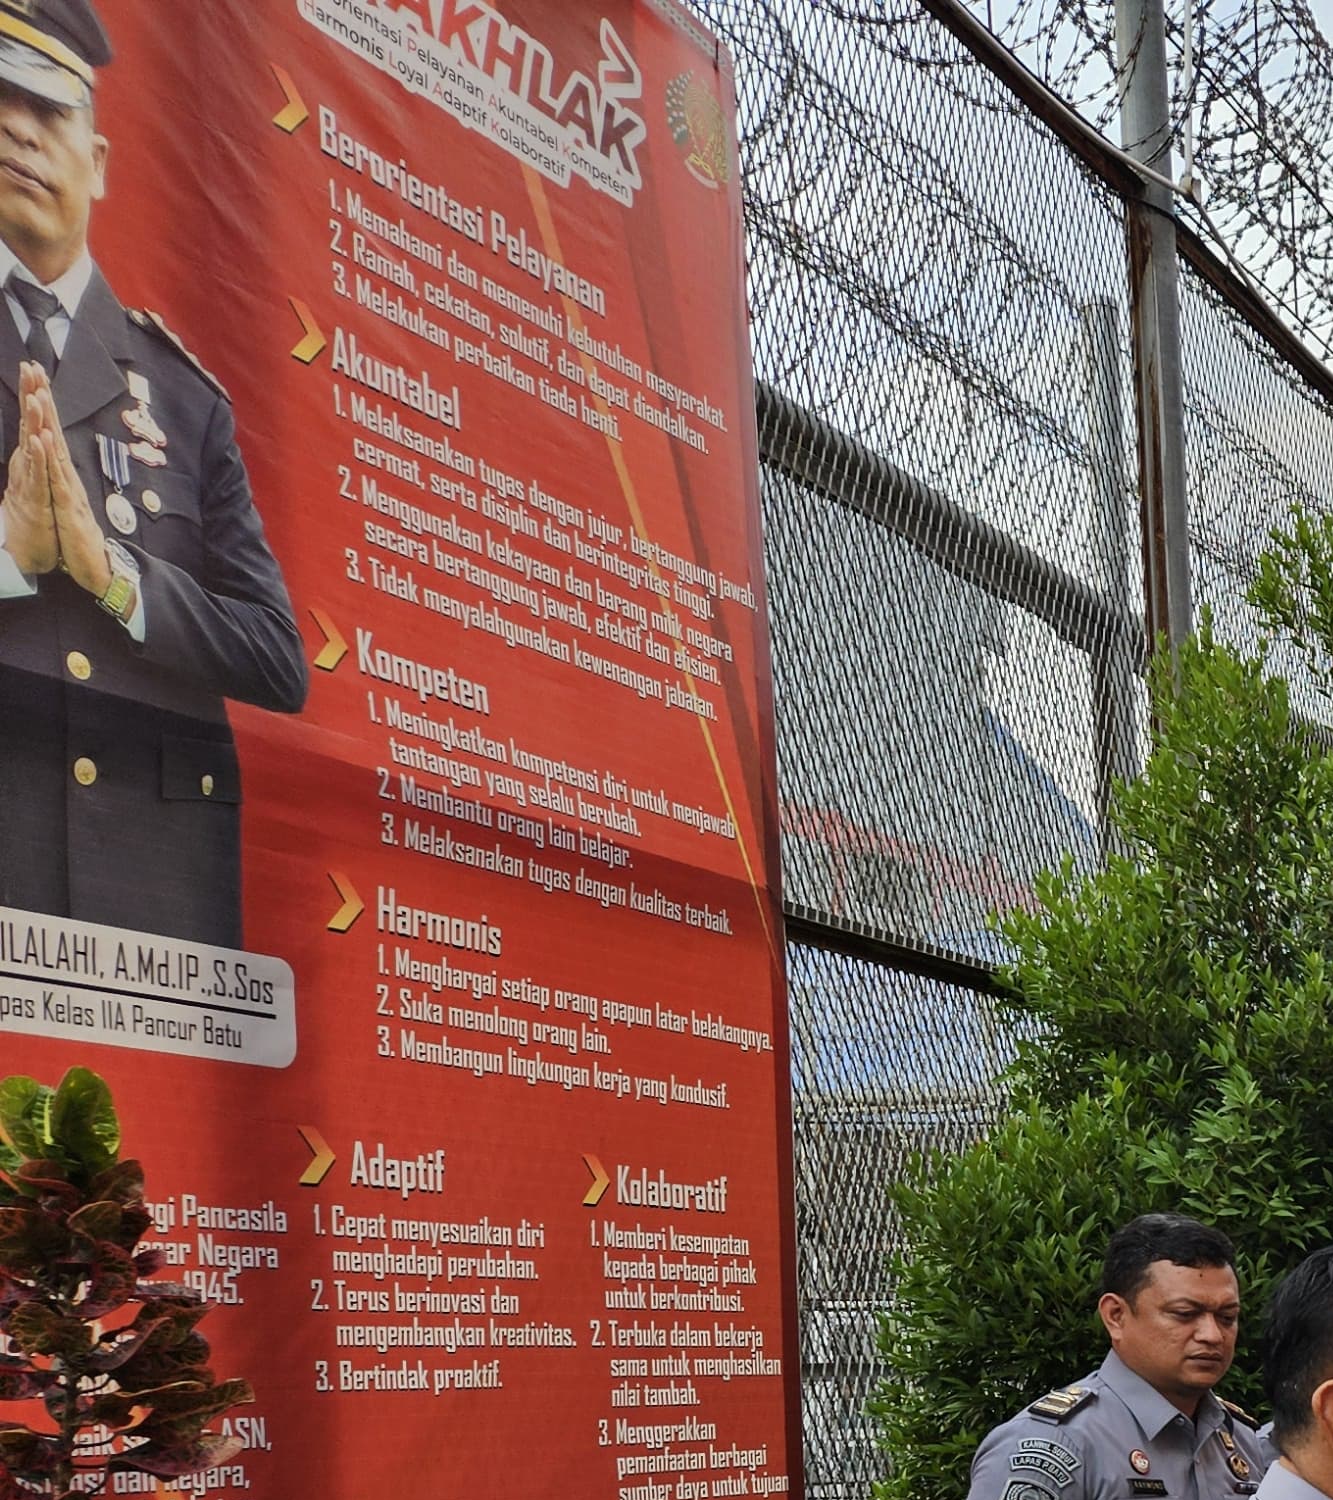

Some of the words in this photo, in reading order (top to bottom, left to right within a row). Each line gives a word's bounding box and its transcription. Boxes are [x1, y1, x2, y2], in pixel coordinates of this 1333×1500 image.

[303, 0, 384, 60] Harmonis
[389, 51, 428, 89] Loyal
[432, 82, 487, 128] Adaptif
[491, 118, 566, 179] Kolaboratif
[333, 0, 402, 46] orientasi
[407, 38, 484, 101] Pelayanan
[488, 93, 558, 152] Akuntabel
[562, 144, 629, 200] Kompeten
[366, 0, 638, 176] AKHLAK
[319, 103, 484, 245] Berorientasi
[491, 210, 605, 317] Pelayanan
[346, 187, 443, 271] Memahami
[447, 249, 478, 290] dan
[482, 276, 563, 338] memenuhi
[567, 316, 642, 383] kebutuhan
[646, 370, 728, 431] masyarakat.
[353, 231, 419, 298] Ramah,
[424, 280, 495, 339] cekatan,
[500, 323, 553, 371] solutif,
[557, 348, 585, 386] dan
[589, 367, 630, 411] dapat
[633, 392, 709, 454] diandalkan.
[356, 273, 450, 351] Melakukan
[454, 336, 535, 395] perbaikan
[538, 377, 577, 418] tiada
[581, 395, 623, 441] henti.
[332, 326, 461, 430] Akuntabel
[351, 391, 475, 477] Melaksanakan
[479, 458, 524, 500] tugas
[528, 480, 584, 528] dengan
[630, 525, 716, 596] bertanggung
[719, 572, 758, 612] jawab,
[354, 438, 425, 489] cermat,
[430, 472, 477, 512] serta
[481, 488, 539, 538] disiplin
[543, 518, 571, 553] dan
[575, 530, 670, 599] berintegritas
[673, 582, 715, 621] tinggi.
[362, 475, 482, 554] Menggunakan
[486, 530, 560, 588] kekayaan
[565, 566, 592, 601] dan
[595, 578, 647, 630] barang
[651, 609, 683, 641] milik
[686, 626, 733, 661] negara
[367, 556, 420, 604] Tidak
[424, 587, 570, 662] menyalahgunakan
[573, 639, 662, 699] kewenangan
[665, 679, 718, 721] jabatan.
[356, 627, 490, 714] Kompeten
[384, 696, 507, 763] Meningkatkan
[510, 737, 600, 794] kompetensi
[603, 770, 628, 803] diri
[631, 787, 670, 816] untuk
[672, 801, 736, 839] menjawab
[389, 737, 481, 788] tantangan
[484, 770, 526, 807] yang
[528, 780, 575, 816] selalu
[577, 791, 641, 836] berubah.
[400, 772, 492, 826] Membantu
[497, 810, 544, 848] orang
[548, 817, 575, 850] lain
[579, 826, 633, 868] belajar.
[0, 920, 104, 979] ILALAHI,
[377, 886, 501, 955] Harmonis
[0, 995, 35, 1023] pas
[43, 990, 94, 1027] Kelas
[101, 999, 126, 1032] IIA
[132, 1004, 197, 1041] Pancur
[203, 1015, 242, 1048] Batu
[395, 946, 497, 999] Menghargai
[501, 977, 550, 1011] setiap
[554, 989, 598, 1021] orang
[602, 1000, 652, 1027] apapun
[655, 1002, 688, 1033] latar
[691, 1009, 774, 1052] belakangnya.
[401, 1029, 503, 1076] Membangun
[508, 1047, 589, 1089] lingkungan
[593, 1061, 631, 1097] kerja
[634, 1075, 667, 1104] yang
[670, 1074, 730, 1108] kondusif.
[350, 1140, 445, 1199] Adaptif
[617, 1164, 727, 1212] Kolaboratif
[182, 1194, 288, 1232] Pancasila
[331, 1204, 387, 1243] Cepat
[391, 1215, 512, 1248] menyesuaikan
[517, 1219, 545, 1248] diri
[604, 1220, 666, 1250] Memberi
[669, 1225, 750, 1258] kesempatan
[197, 1233, 279, 1274] Negara
[332, 1243, 442, 1281] menghadapi
[447, 1249, 539, 1282] perubahan.
[603, 1251, 656, 1283] kepada
[659, 1254, 719, 1287] berbagai
[722, 1259, 757, 1287] pihak
[334, 1280, 390, 1312] Terus
[394, 1282, 485, 1313] berinovasi
[490, 1285, 519, 1314] dan
[605, 1283, 647, 1309] untuk
[650, 1283, 745, 1311] berkontribusi.
[336, 1316, 485, 1352] mengembangkan
[490, 1318, 577, 1347] kreativitas.
[608, 1319, 666, 1347] Terbuka
[670, 1321, 711, 1347] dalam
[714, 1322, 763, 1351] bekerja
[339, 1359, 429, 1391] Bertindak
[433, 1359, 503, 1395] proaktif.
[610, 1358, 648, 1376] sama
[652, 1351, 690, 1376] untuk
[694, 1350, 782, 1380] menghasilkan
[611, 1380, 640, 1406] nilai
[644, 1379, 701, 1406] tambah.
[615, 1415, 716, 1448] Menggerakkan
[617, 1446, 706, 1480] pemanfaatan
[709, 1443, 767, 1471] berbagai
[712, 1470, 749, 1496] untuk
[751, 1472, 789, 1497] tujuan
[1014, 1457, 1041, 1466] LAPAS
